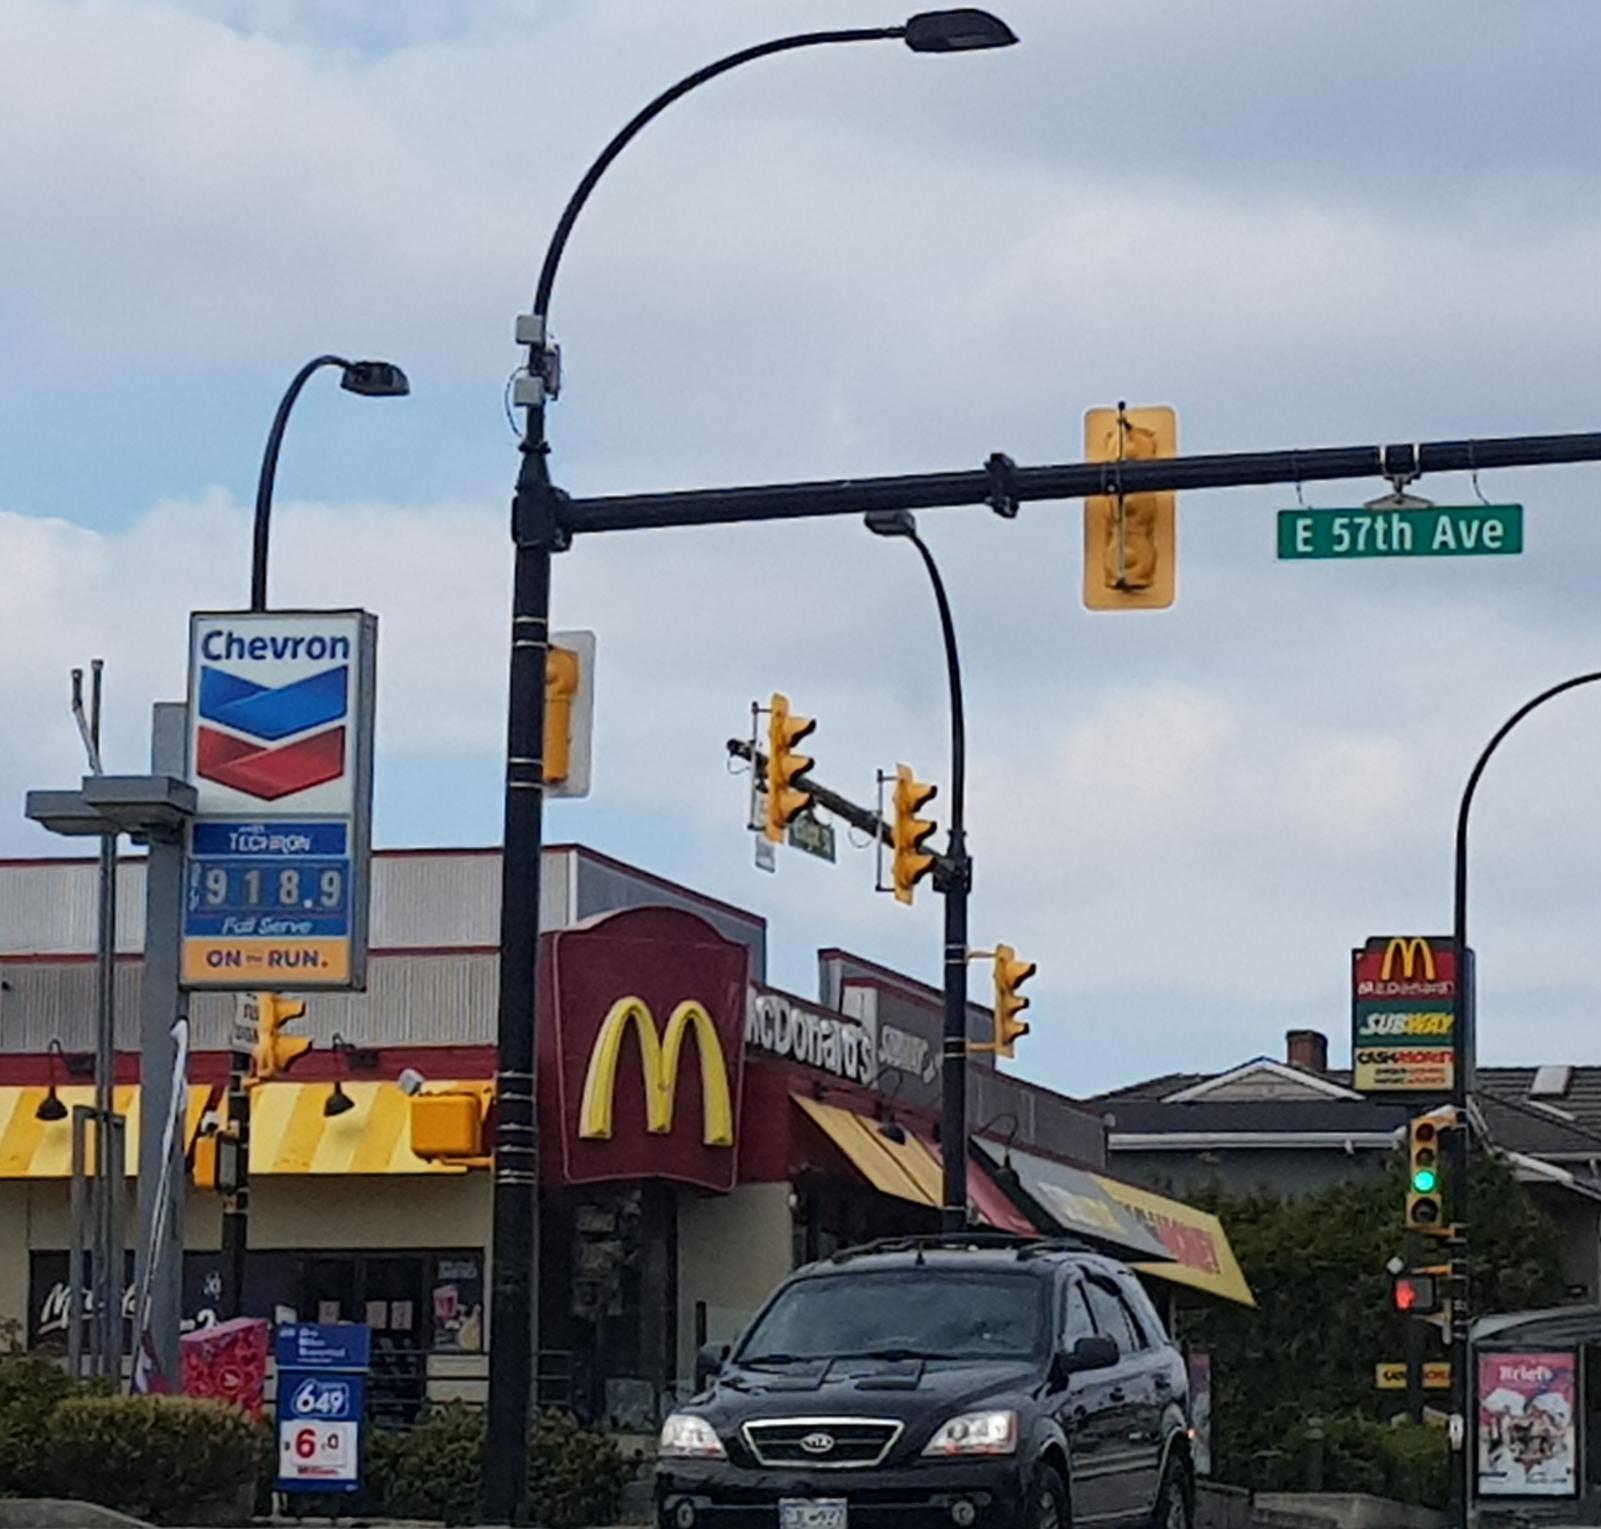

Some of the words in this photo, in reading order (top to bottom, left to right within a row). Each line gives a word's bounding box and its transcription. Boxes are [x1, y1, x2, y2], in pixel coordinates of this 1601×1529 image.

[1296, 518, 1314, 552] E
[1332, 513, 1412, 552] 57th
[1432, 515, 1504, 550] Ave
[202, 630, 350, 661] Chevron
[257, 916, 313, 935] Serve
[206, 949, 242, 968] ON
[1359, 1012, 1456, 1036] SUBWAY
